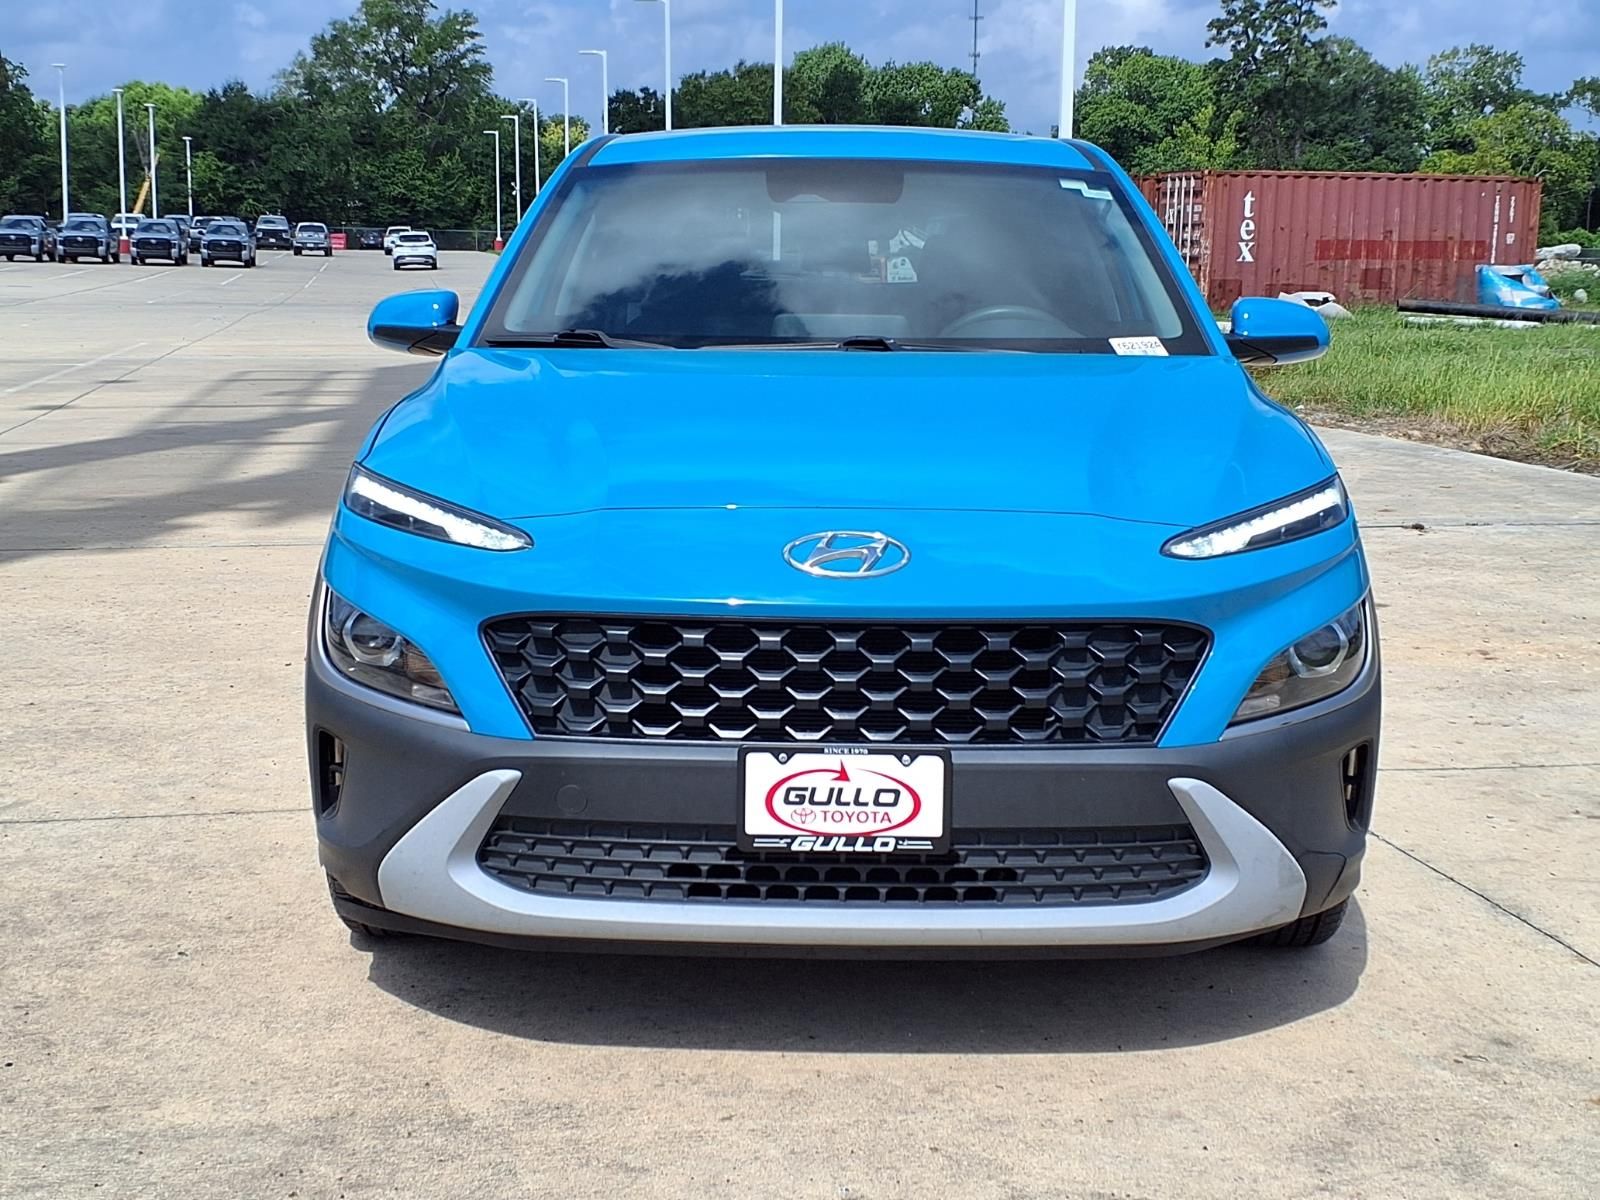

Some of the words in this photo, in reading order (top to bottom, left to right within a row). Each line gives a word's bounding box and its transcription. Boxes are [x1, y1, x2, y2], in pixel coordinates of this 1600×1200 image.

[1236, 190, 1255, 262] tex
[783, 786, 901, 807] GULLO
[820, 810, 893, 825] TOYOTA
[790, 836, 896, 852] GULLO
